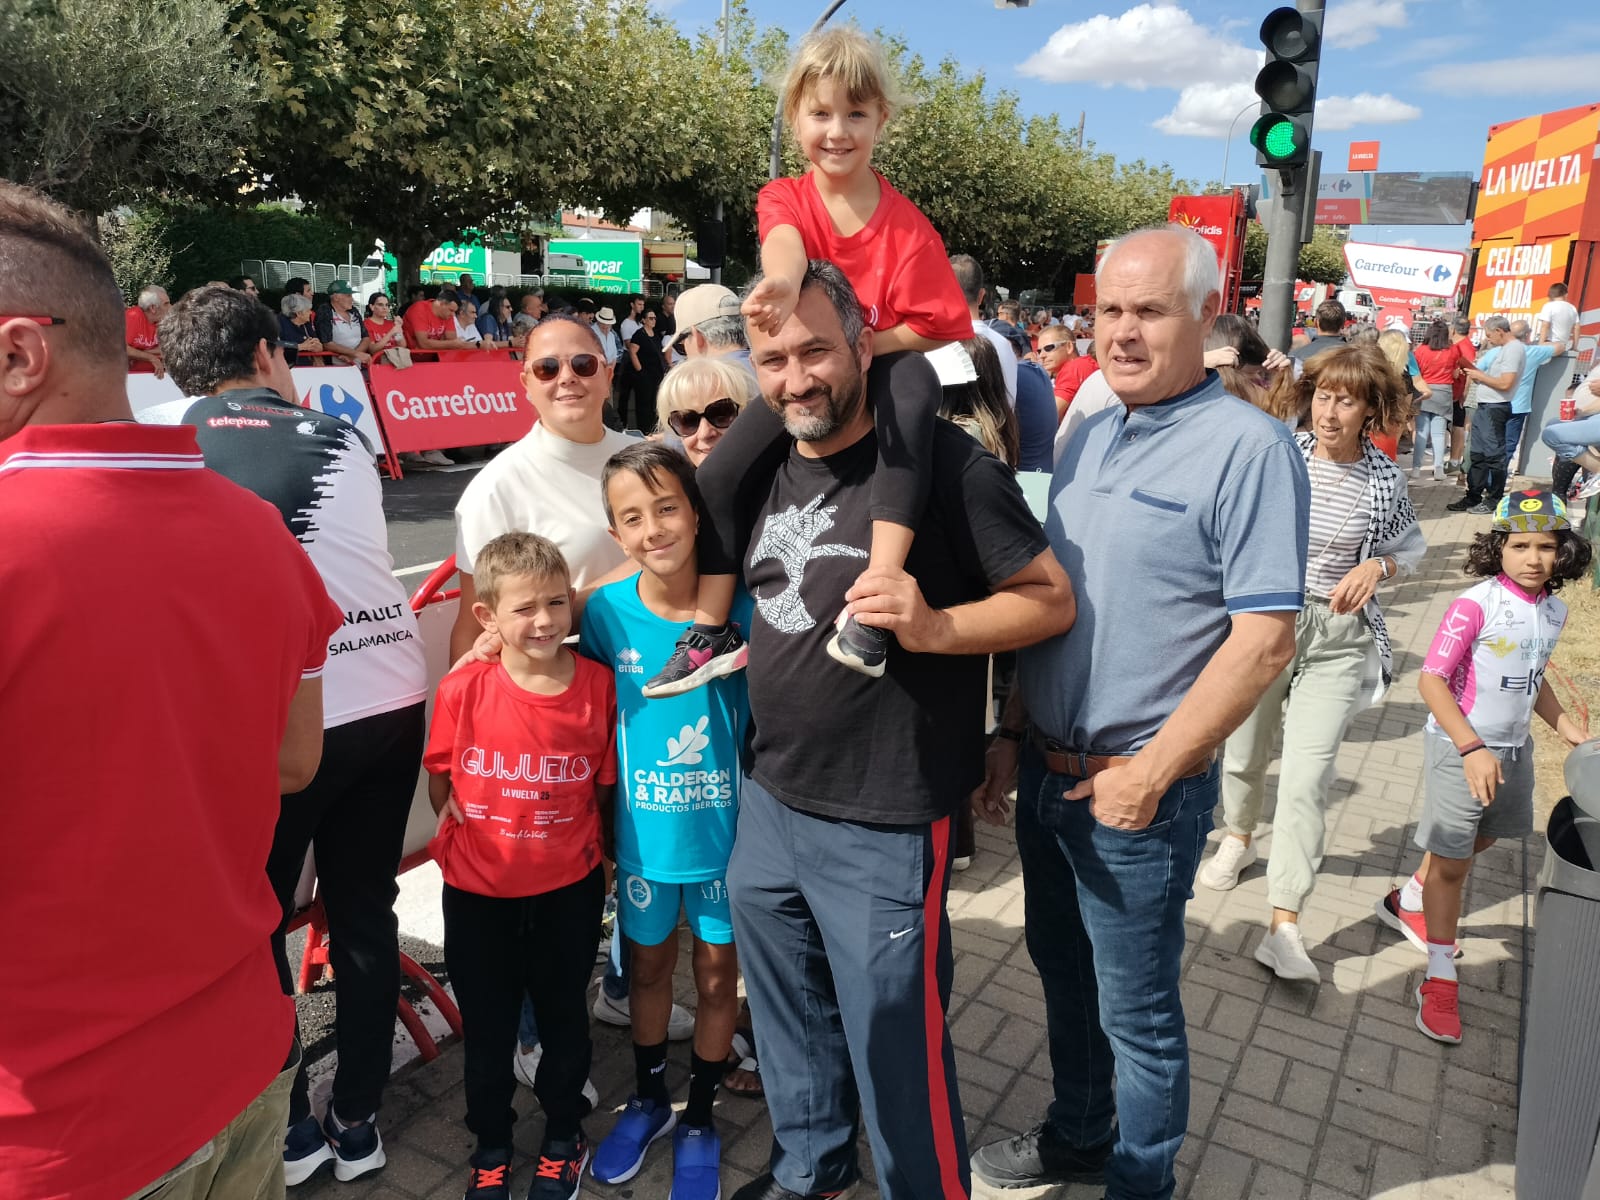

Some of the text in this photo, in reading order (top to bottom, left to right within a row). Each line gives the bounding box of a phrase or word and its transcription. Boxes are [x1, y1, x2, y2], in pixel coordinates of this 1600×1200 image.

[1485, 154, 1581, 196] LA VUELTA
[1187, 225, 1223, 236] ofidis
[1354, 258, 1420, 277] Carrefour
[1486, 244, 1553, 276] CELEBRA
[1492, 279, 1534, 309] CADA
[385, 384, 517, 421] Carrefour
[208, 415, 270, 429] telepizza
[328, 629, 413, 656] SALAMANCA
[1438, 604, 1470, 658] EKT
[461, 748, 590, 782] GUIJUELO
[501, 787, 511, 797] LA
[511, 789, 539, 801] VUELTA
[634, 783, 732, 804] & RAMOS
[635, 798, 733, 814] PRODUCTOS IBÉRICOS
